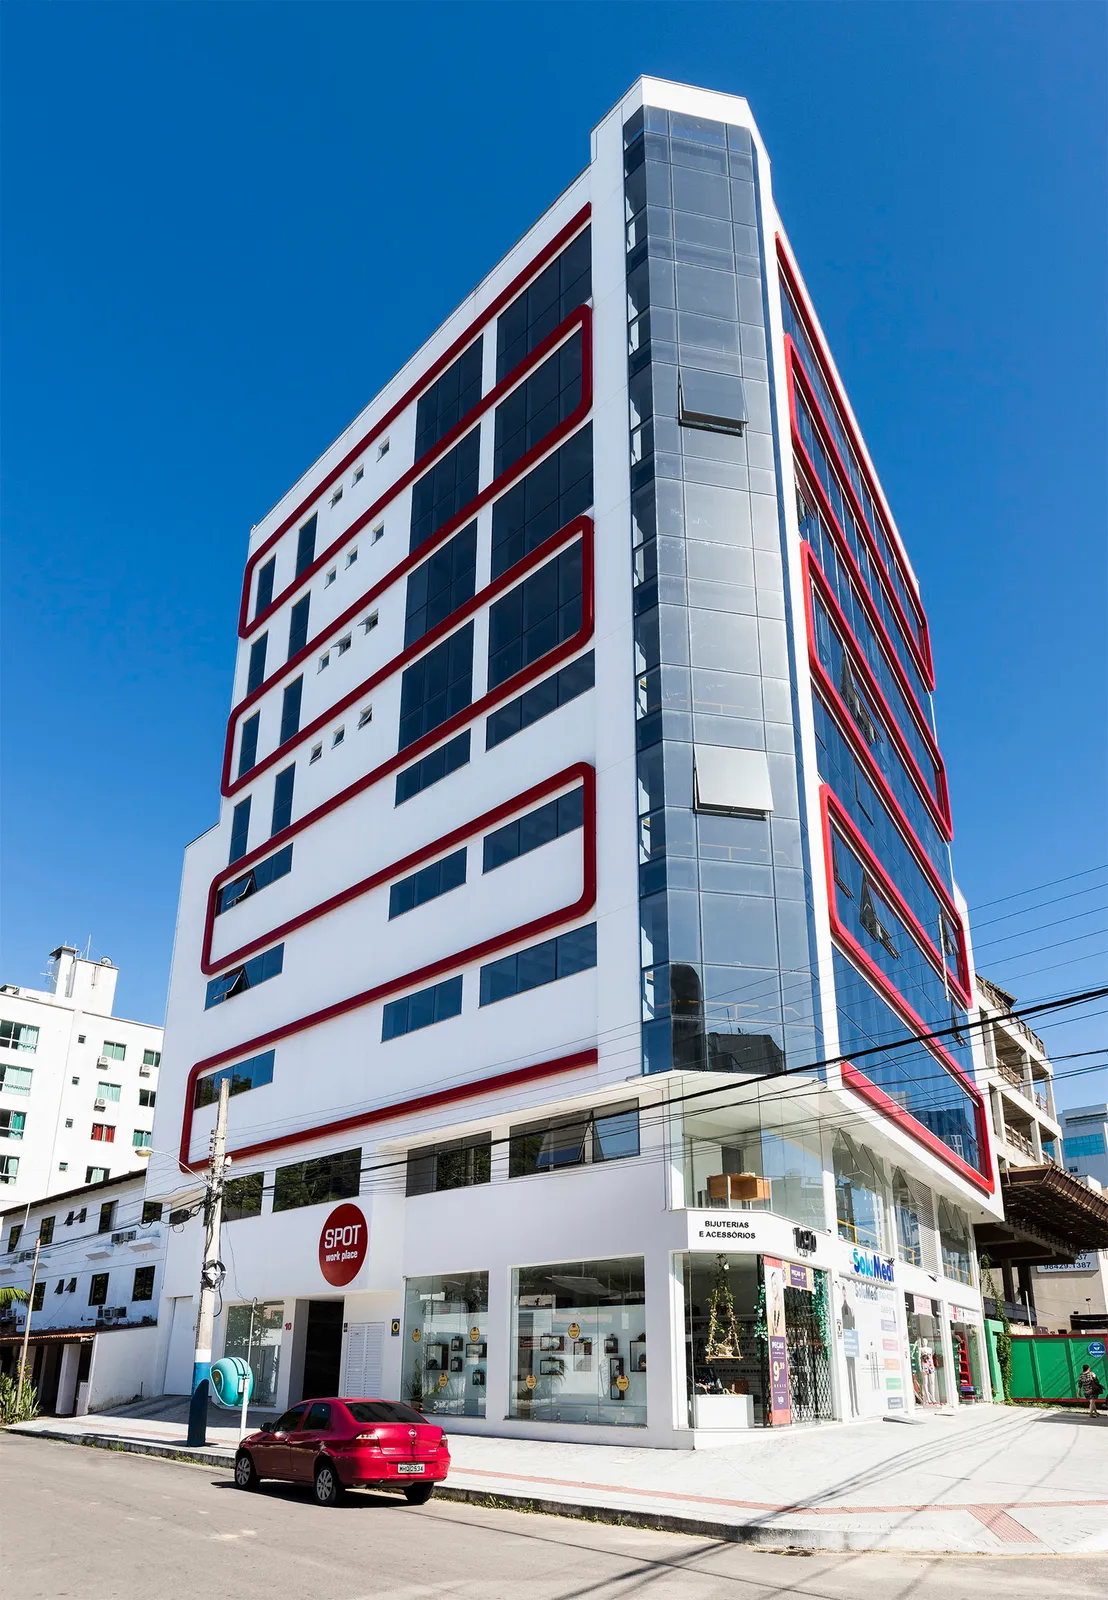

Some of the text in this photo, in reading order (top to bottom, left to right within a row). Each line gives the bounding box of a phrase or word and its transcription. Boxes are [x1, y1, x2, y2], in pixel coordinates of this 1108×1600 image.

[705, 1220, 749, 1229] BIJUTERIAS
[325, 1224, 362, 1249] SPOT
[706, 1230, 756, 1239] ACESSÓRIOS
[325, 1250, 358, 1262] work place
[284, 1322, 292, 1331] 10
